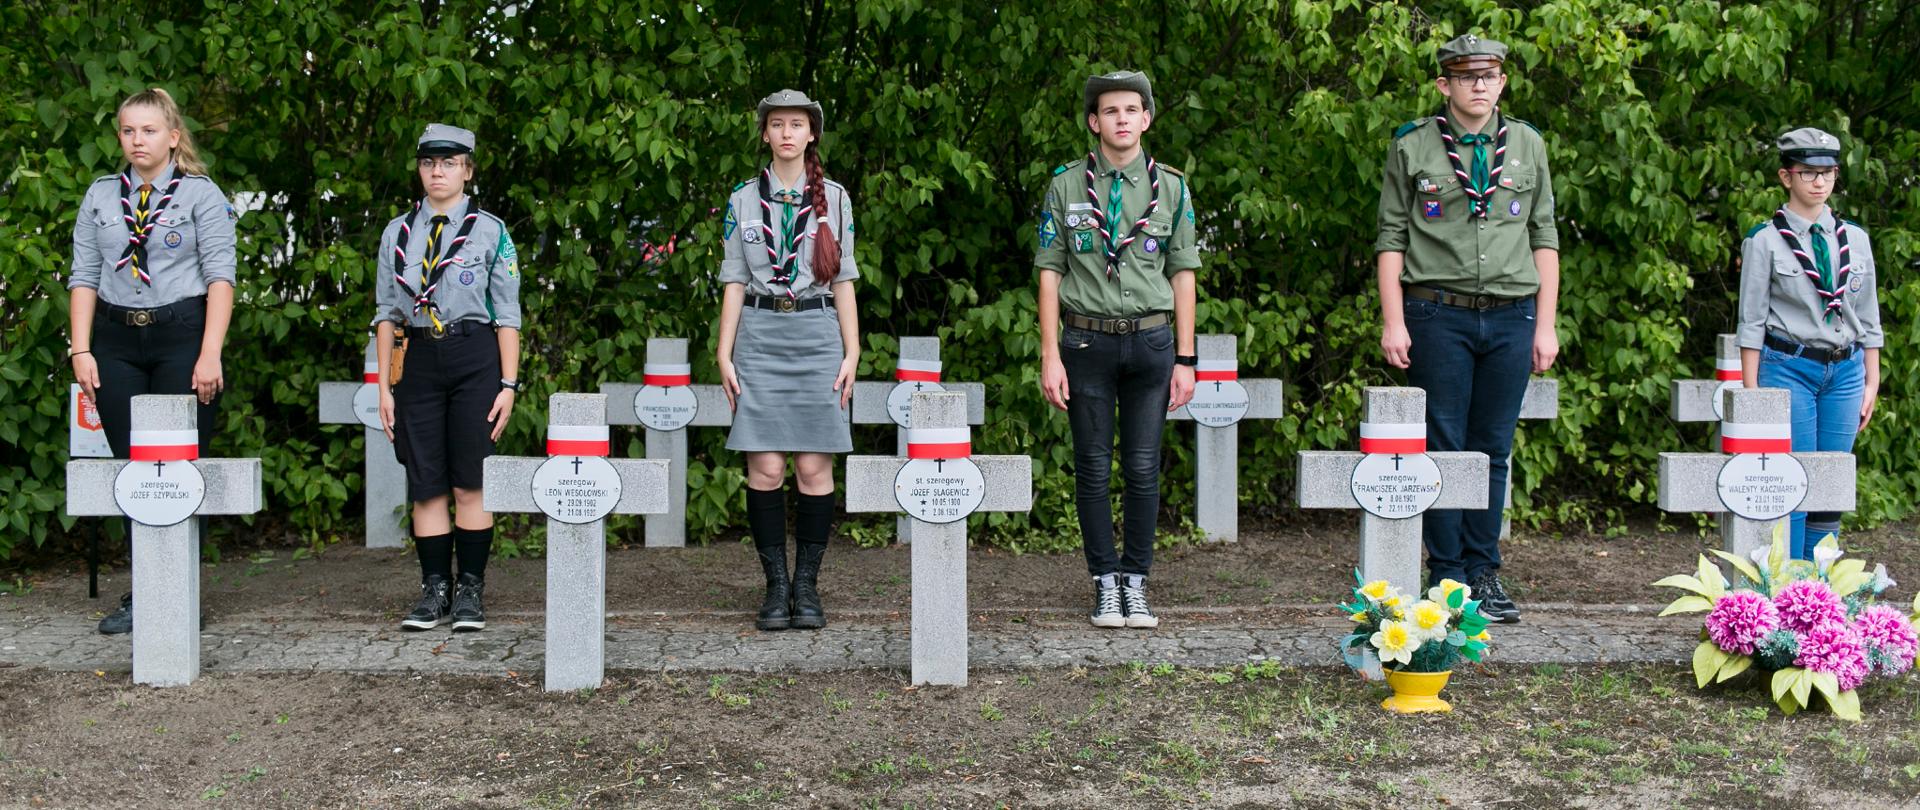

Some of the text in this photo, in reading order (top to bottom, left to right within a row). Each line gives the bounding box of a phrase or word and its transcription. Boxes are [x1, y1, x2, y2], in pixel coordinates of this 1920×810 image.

[558, 479, 597, 487] szeregowy
[926, 478, 965, 486] szeregowy
[1378, 475, 1418, 483] szeregowy
[1744, 475, 1784, 483] szeregowy
[140, 481, 180, 490] szeregowy
[1357, 485, 1437, 493] FRANCISZEK JARZEWSKI
[1729, 485, 1798, 493] WALENTY KACZMAREK
[153, 491, 190, 499] SZYPULSKI
[544, 488, 563, 497] LEON
